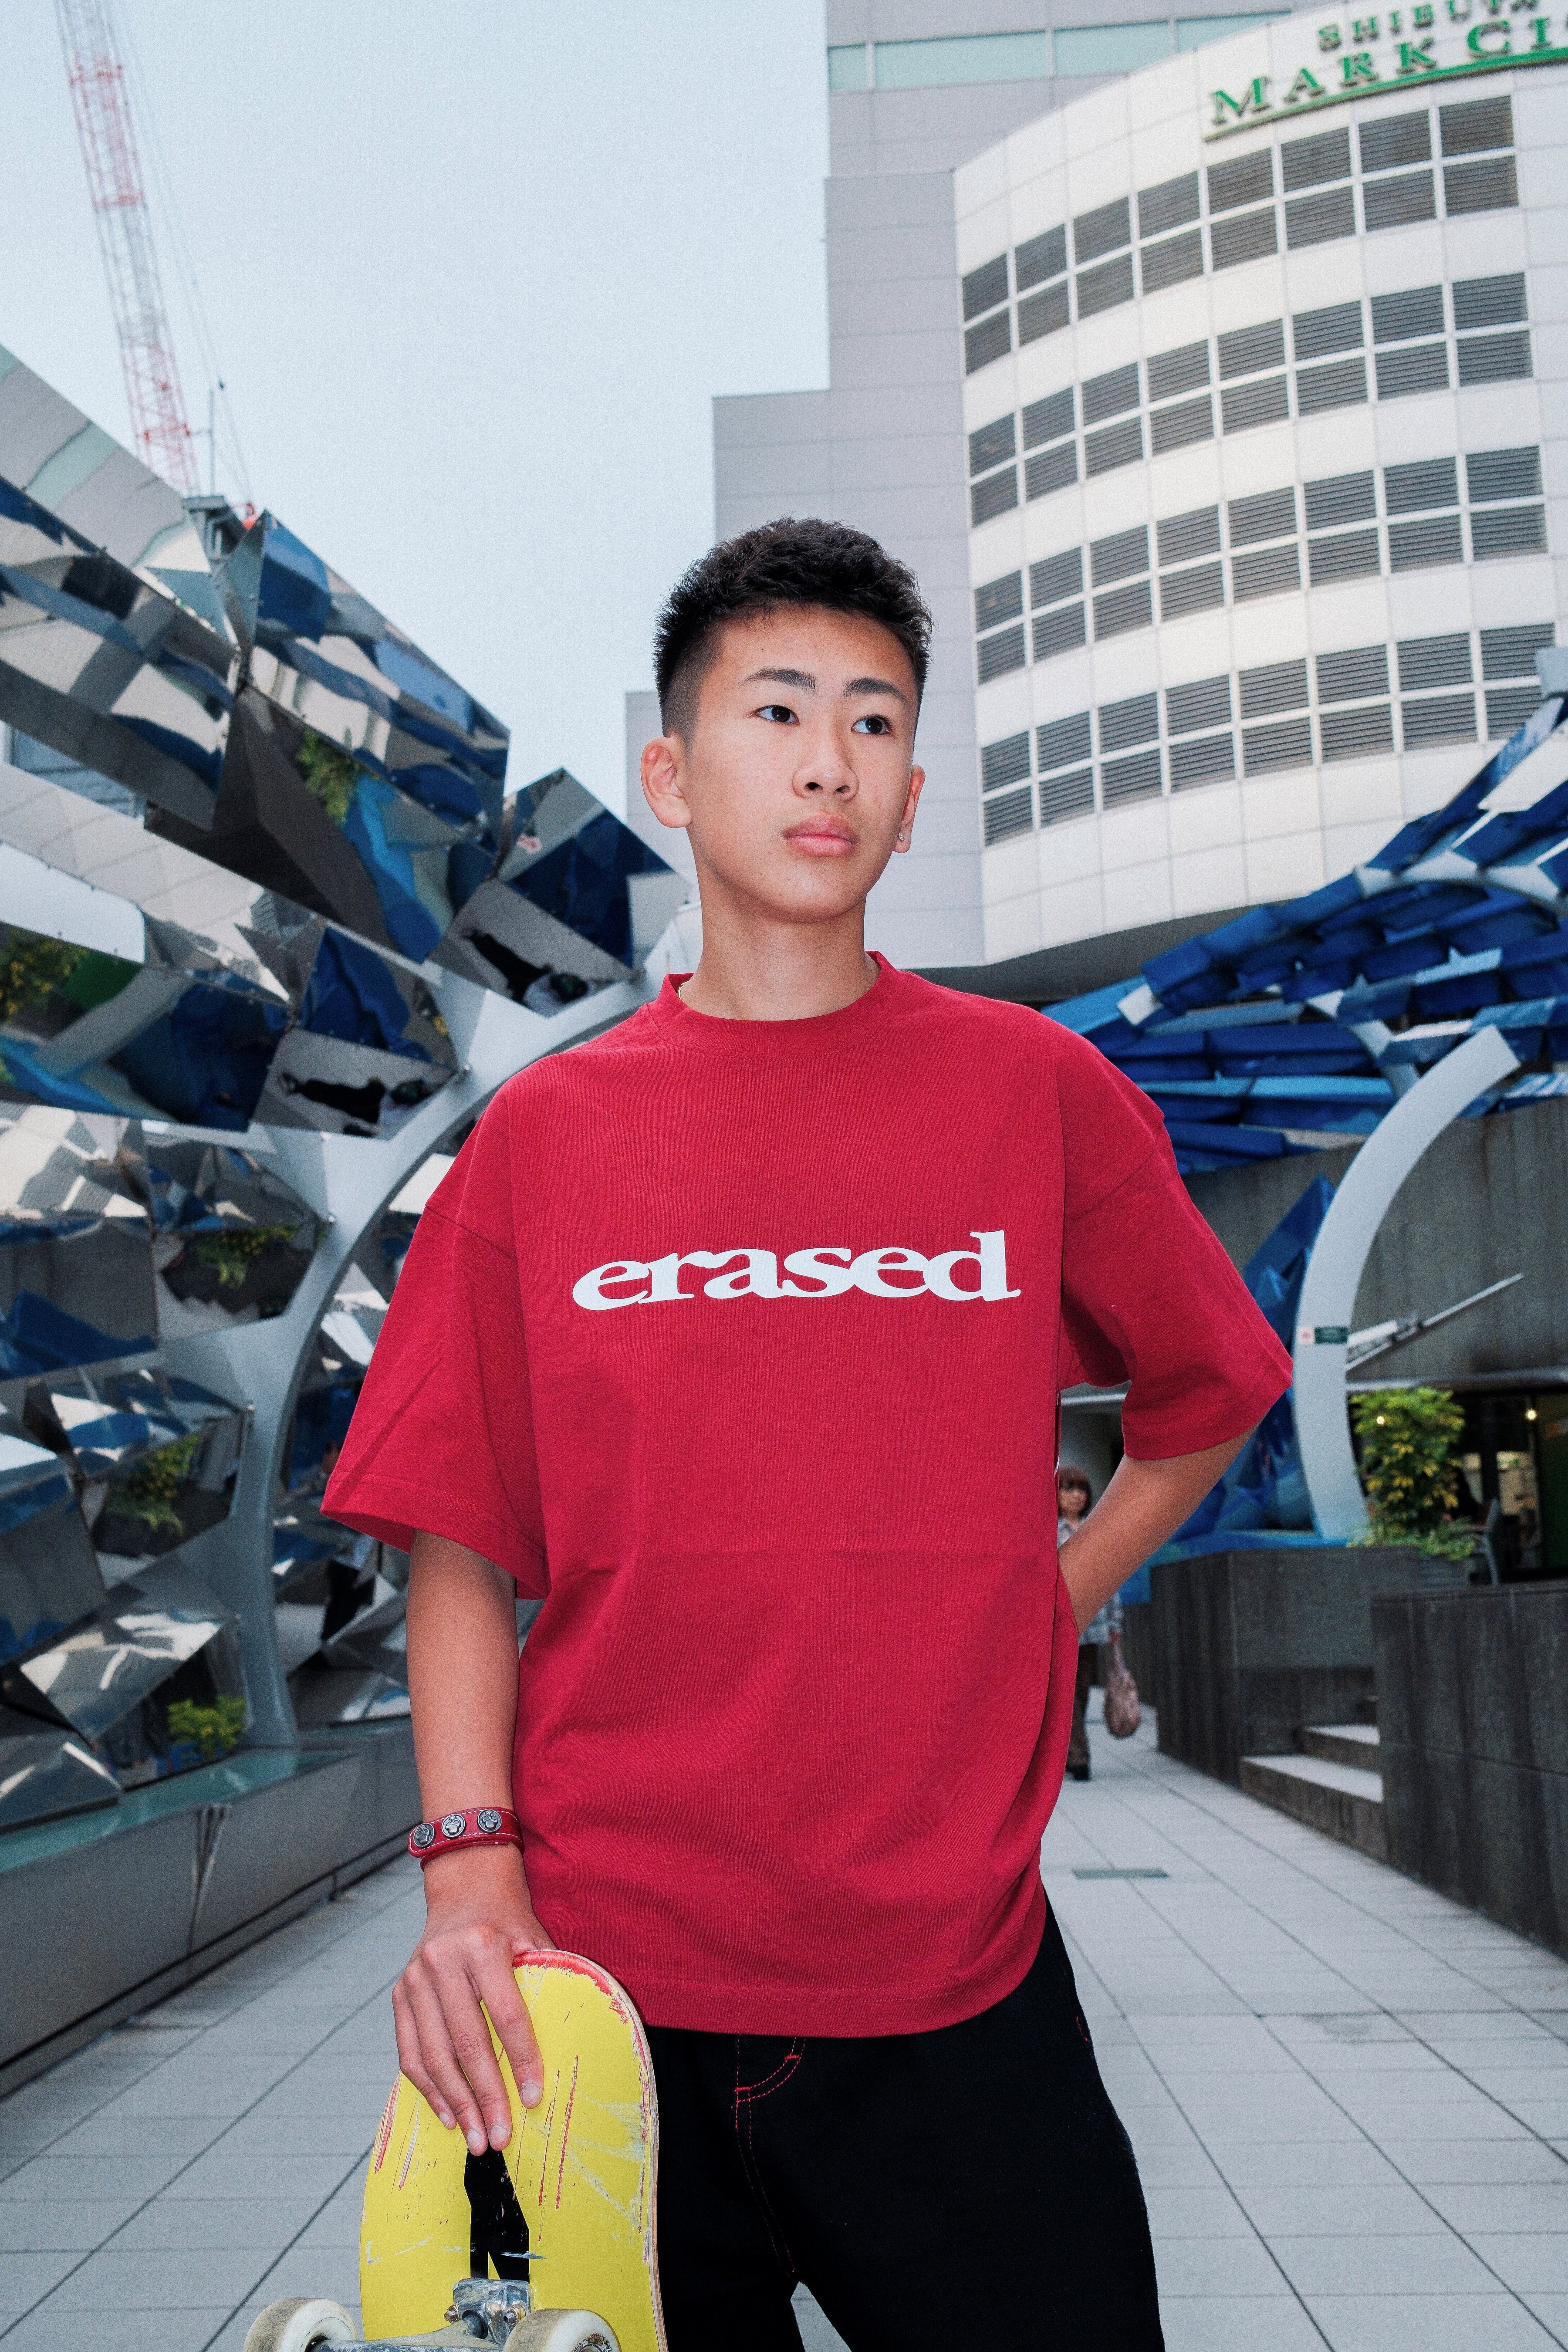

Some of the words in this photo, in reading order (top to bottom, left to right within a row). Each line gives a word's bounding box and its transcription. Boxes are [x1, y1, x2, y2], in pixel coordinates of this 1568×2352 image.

[1210, 36, 1436, 125] MARK
[1467, 14, 1568, 59] CI
[572, 1230, 1021, 1311] erased
